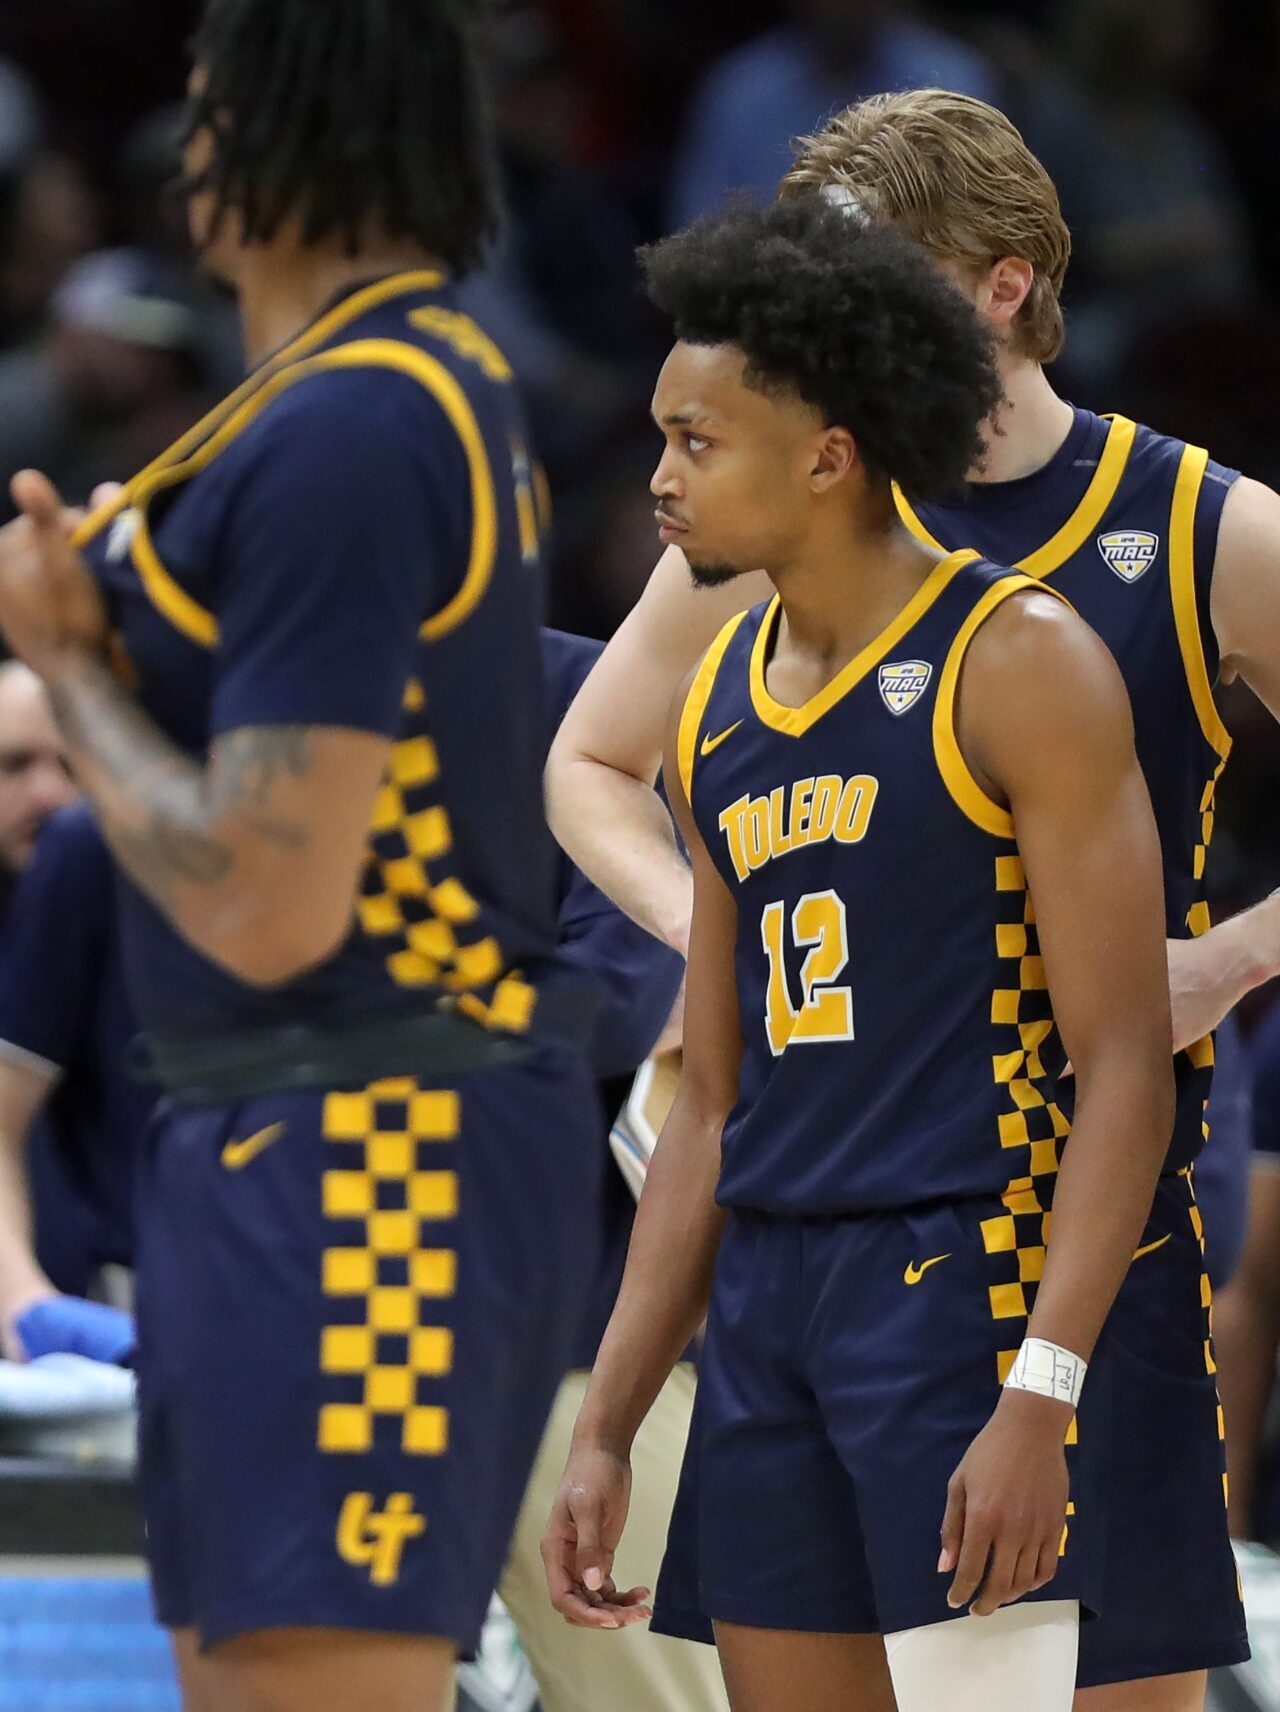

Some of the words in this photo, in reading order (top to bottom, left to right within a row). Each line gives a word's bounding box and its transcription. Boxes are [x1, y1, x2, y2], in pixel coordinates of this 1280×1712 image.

[1104, 546, 1155, 560] MAC
[880, 677, 926, 691] MAC
[718, 774, 879, 884] TOLEDO
[761, 888, 855, 1057] 12
